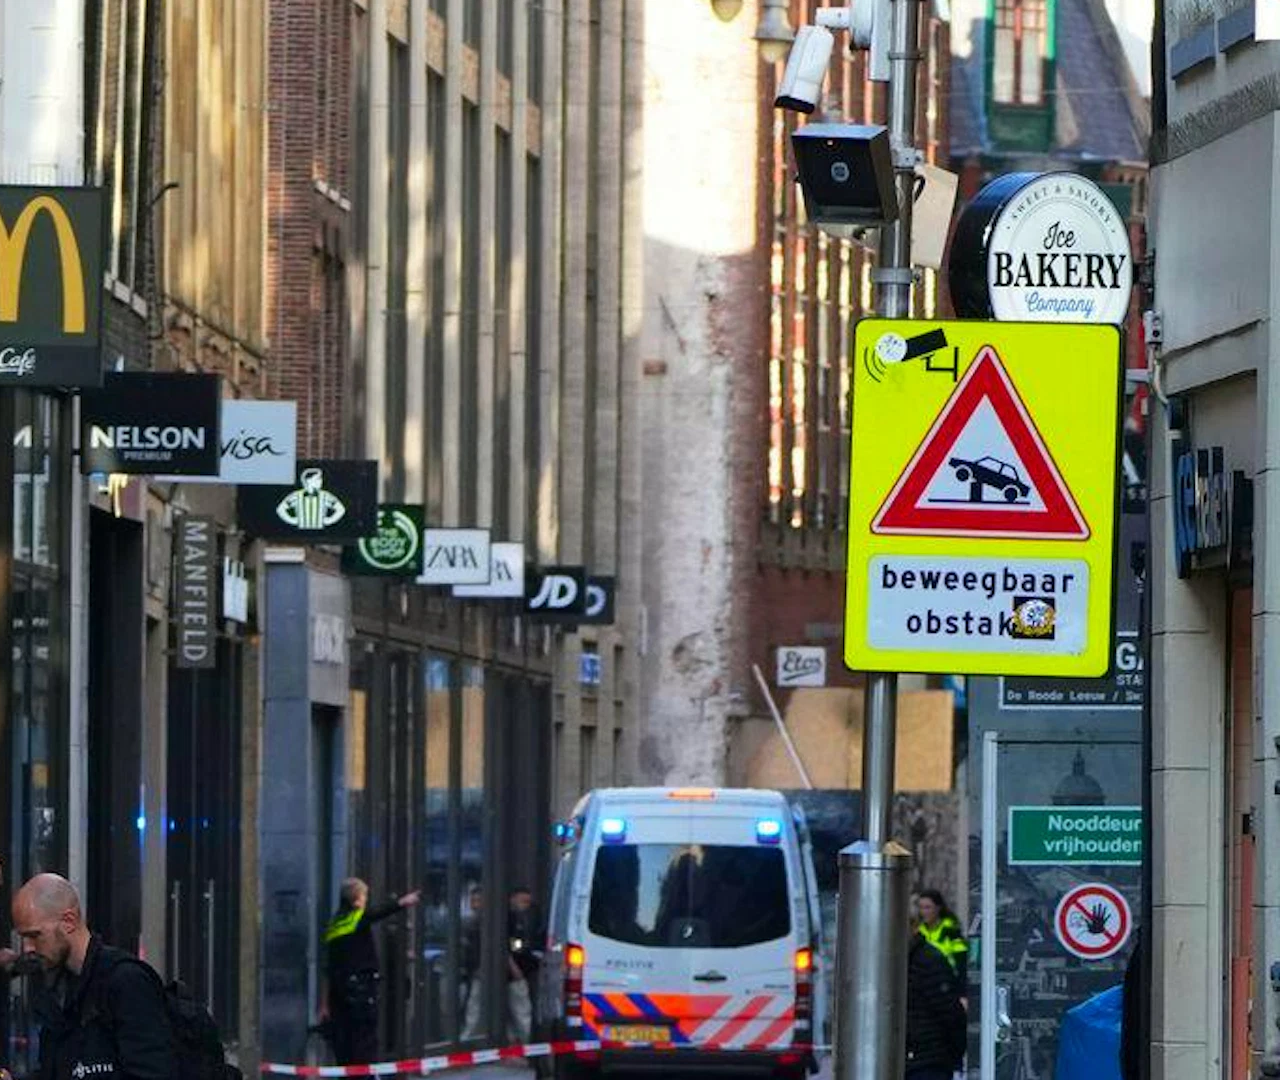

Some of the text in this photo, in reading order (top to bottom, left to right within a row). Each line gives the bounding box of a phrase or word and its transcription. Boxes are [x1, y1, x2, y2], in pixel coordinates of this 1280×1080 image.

[993, 252, 1127, 289] BAKERY
[1025, 291, 1095, 318] Company
[91, 425, 206, 450] NELSON
[124, 452, 171, 461] PREMIUM
[371, 537, 406, 549] BODY
[372, 548, 406, 559] SHOP
[183, 520, 208, 662] MANFIELD
[529, 574, 578, 608] JD
[881, 564, 1075, 599] beweegbaar
[584, 584, 607, 616] D
[906, 609, 1015, 637] obstak
[1007, 690, 1023, 701] De
[1048, 815, 1142, 832] Nooddeur
